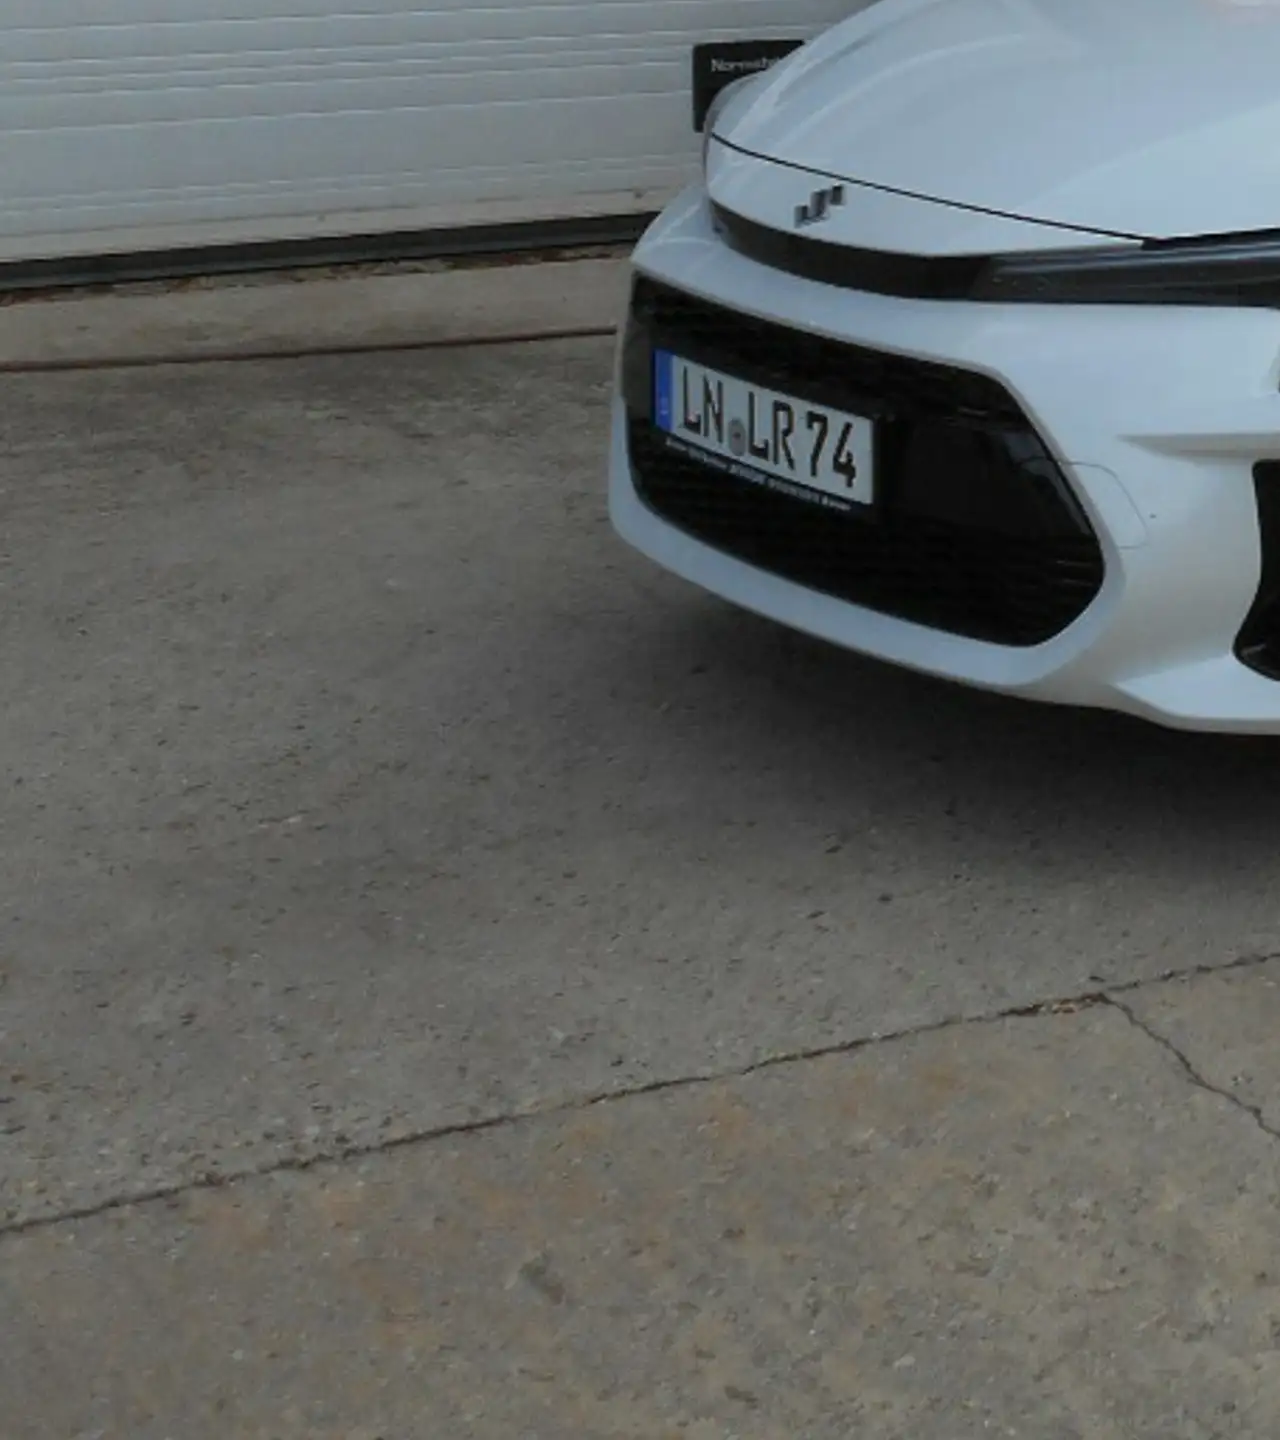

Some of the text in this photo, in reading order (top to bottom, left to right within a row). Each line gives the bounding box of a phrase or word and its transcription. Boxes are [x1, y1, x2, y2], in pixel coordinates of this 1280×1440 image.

[683, 366, 856, 488] LN LR 74
